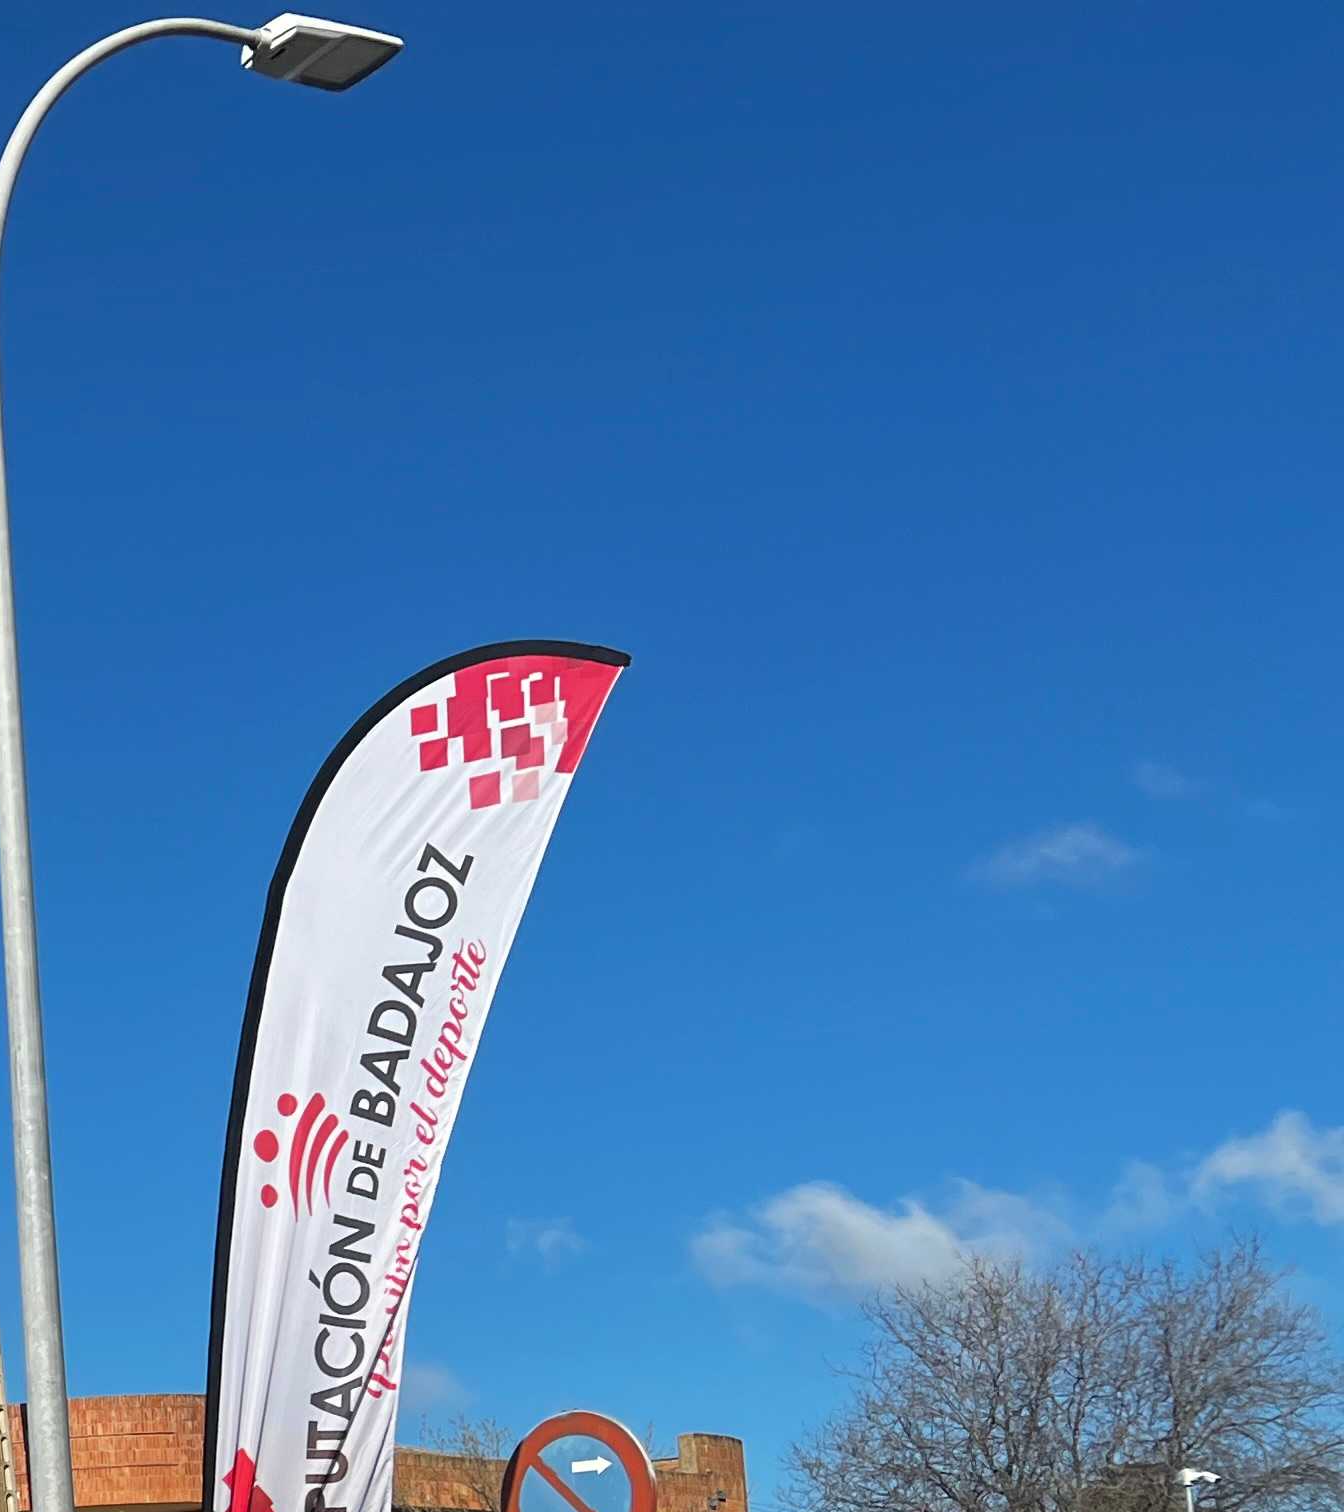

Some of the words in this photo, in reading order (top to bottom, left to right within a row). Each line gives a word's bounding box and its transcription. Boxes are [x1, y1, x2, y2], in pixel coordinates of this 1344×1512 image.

[350, 842, 475, 1128] BADAJOZ
[421, 937, 489, 1100] deporte
[410, 1101, 439, 1146] el
[346, 1139, 387, 1200] DE
[399, 1153, 429, 1231] por
